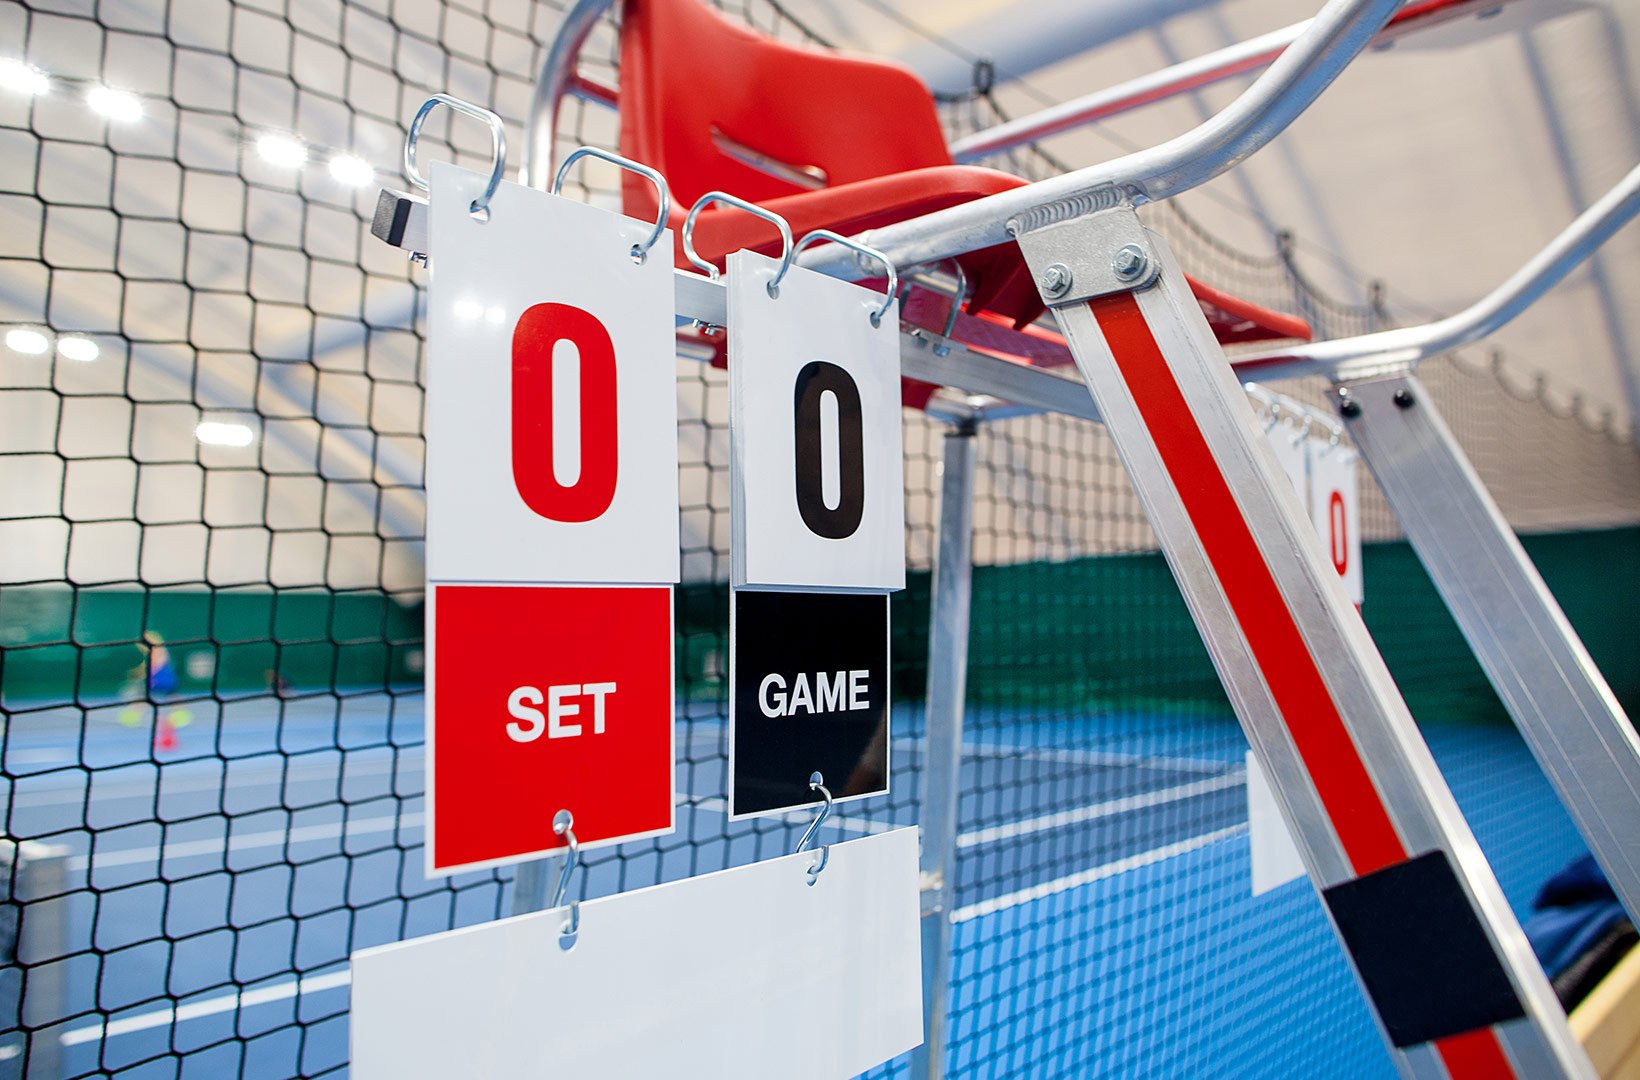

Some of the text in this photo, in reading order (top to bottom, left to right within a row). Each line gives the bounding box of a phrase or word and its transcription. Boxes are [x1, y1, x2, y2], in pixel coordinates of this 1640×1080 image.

[512, 302, 618, 523] 0
[794, 361, 864, 539] 0
[1330, 490, 1347, 576] 0
[506, 682, 616, 742] SET
[758, 670, 870, 717] GAME
